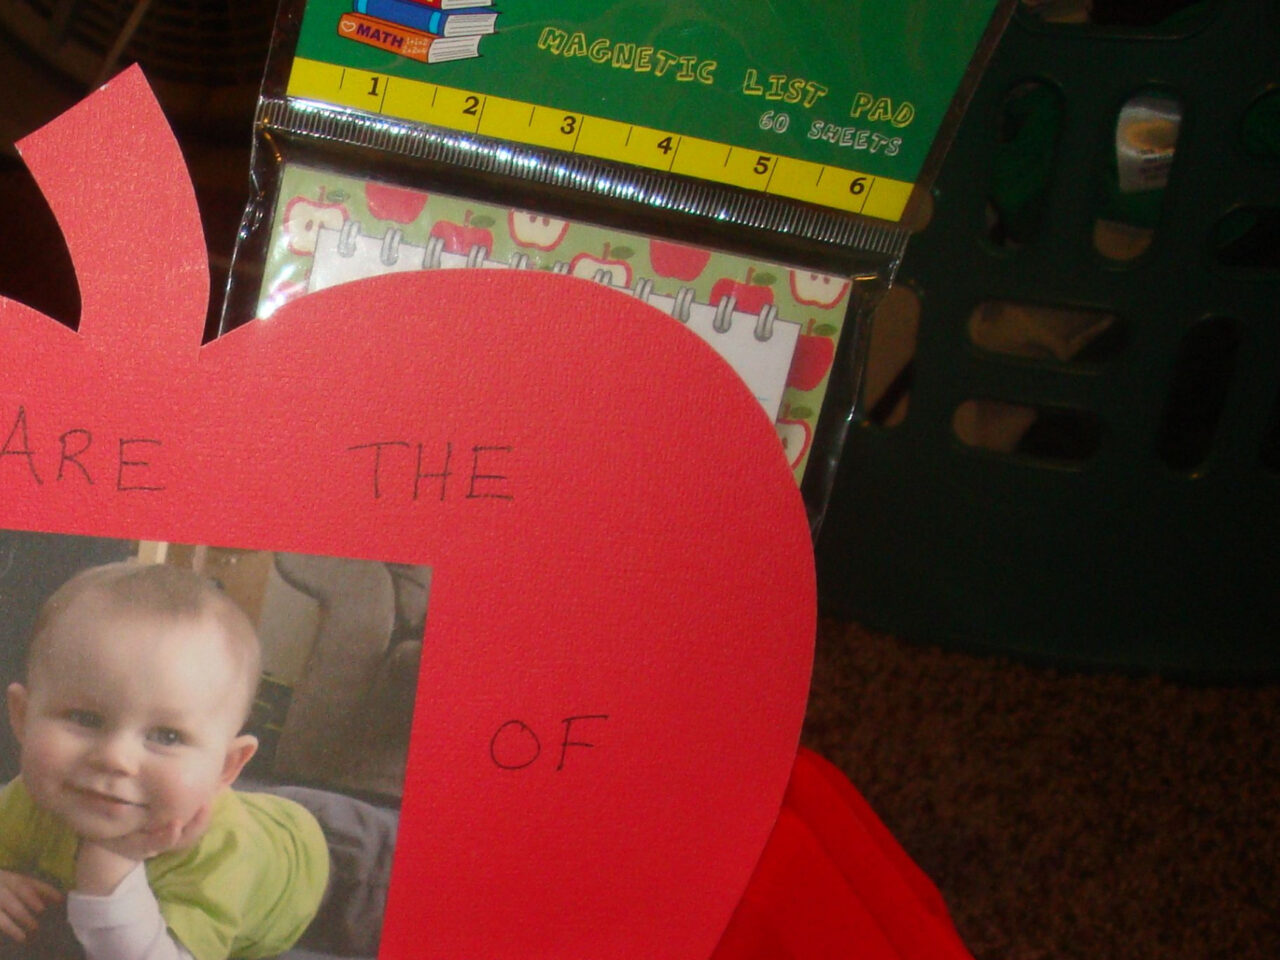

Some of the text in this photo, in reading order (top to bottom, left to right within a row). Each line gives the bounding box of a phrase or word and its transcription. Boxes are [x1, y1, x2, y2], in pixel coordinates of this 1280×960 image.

[356, 23, 405, 50] MATH
[537, 27, 916, 128] MAGNETIC LIST PAD
[367, 77, 867, 195] 1 2 3 4 5 6
[758, 110, 904, 157] 60 SHEETS
[346, 441, 515, 501] THE
[489, 714, 610, 771] OF
